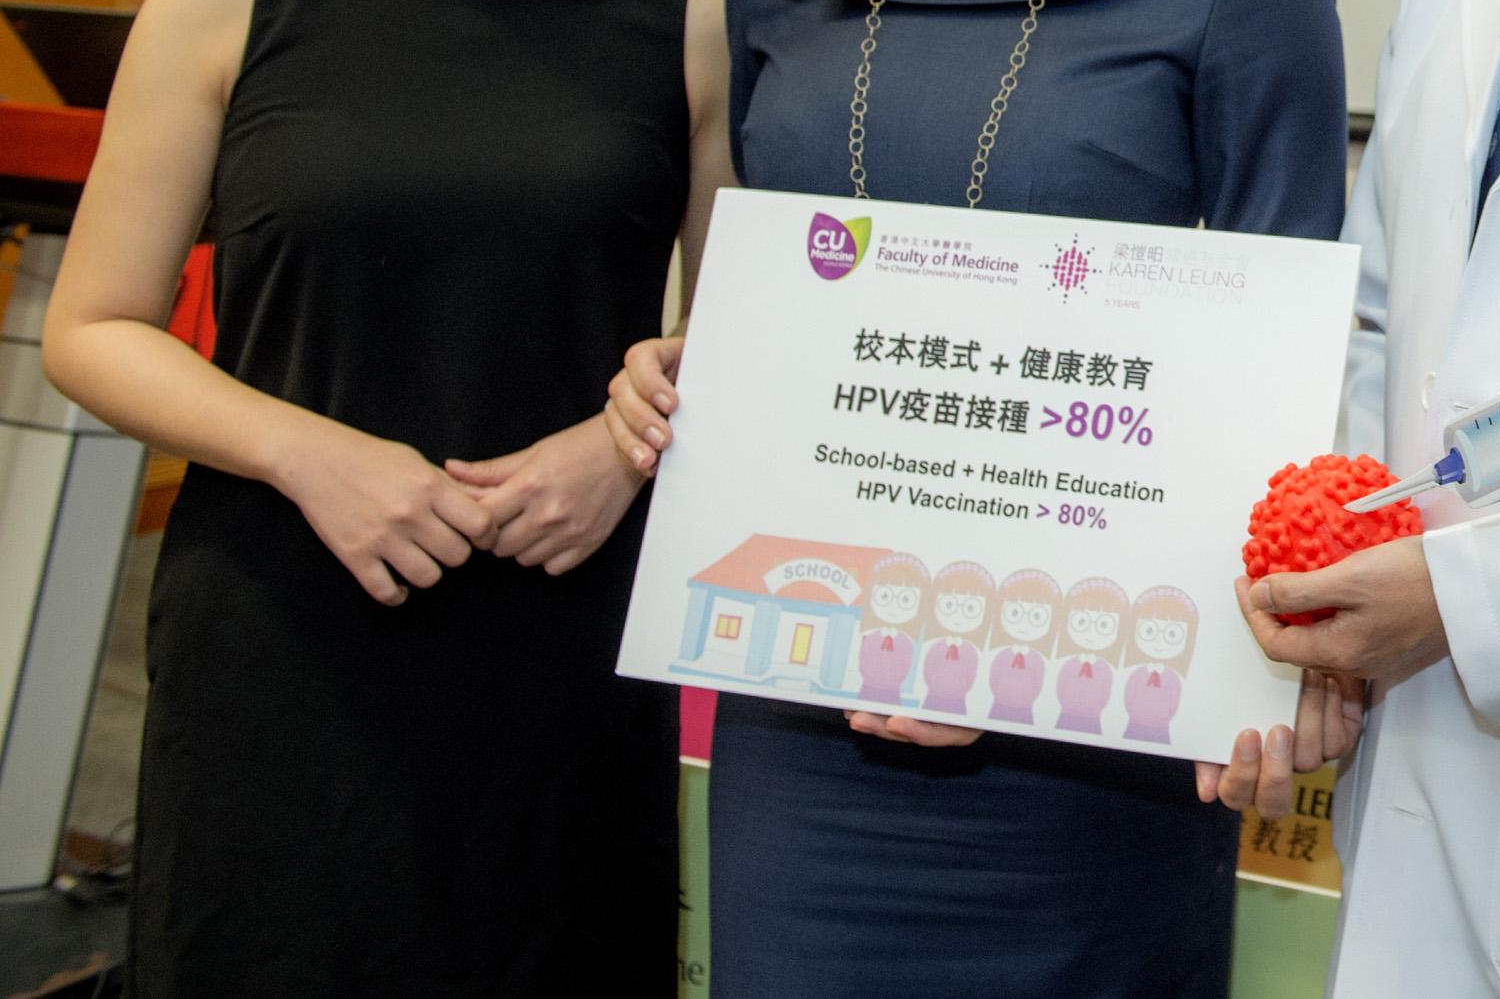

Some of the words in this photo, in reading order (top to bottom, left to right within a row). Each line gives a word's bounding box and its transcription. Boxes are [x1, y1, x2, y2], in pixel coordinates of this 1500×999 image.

[813, 229, 847, 251] CU
[810, 248, 855, 262] Medicine
[877, 247, 927, 267] Faculty
[932, 252, 949, 266] of
[952, 254, 1019, 273] Medicine
[874, 263, 889, 272] The
[891, 265, 920, 275] Chinese
[922, 267, 960, 280] University
[962, 270, 972, 279] of
[972, 272, 995, 283] Hong
[996, 275, 1018, 285] Kong
[1108, 262, 1174, 282] KAREN
[1178, 268, 1246, 289] LEUNG
[1112, 299, 1141, 310] YEARS
[853, 328, 982, 373] 校本模式
[989, 355, 1010, 376] +
[1019, 345, 1153, 390] 健康教育
[833, 383, 1030, 434] HPV疫苗接種
[1039, 401, 1154, 446] >80%
[814, 444, 956, 478] School-based
[962, 465, 975, 478] +
[981, 463, 1049, 489] Health
[1055, 472, 1165, 503] Education
[856, 481, 902, 502] HPV
[907, 486, 1029, 520] Vaccination
[1058, 504, 1107, 529] 80%
[783, 563, 850, 590] SCHOOL
